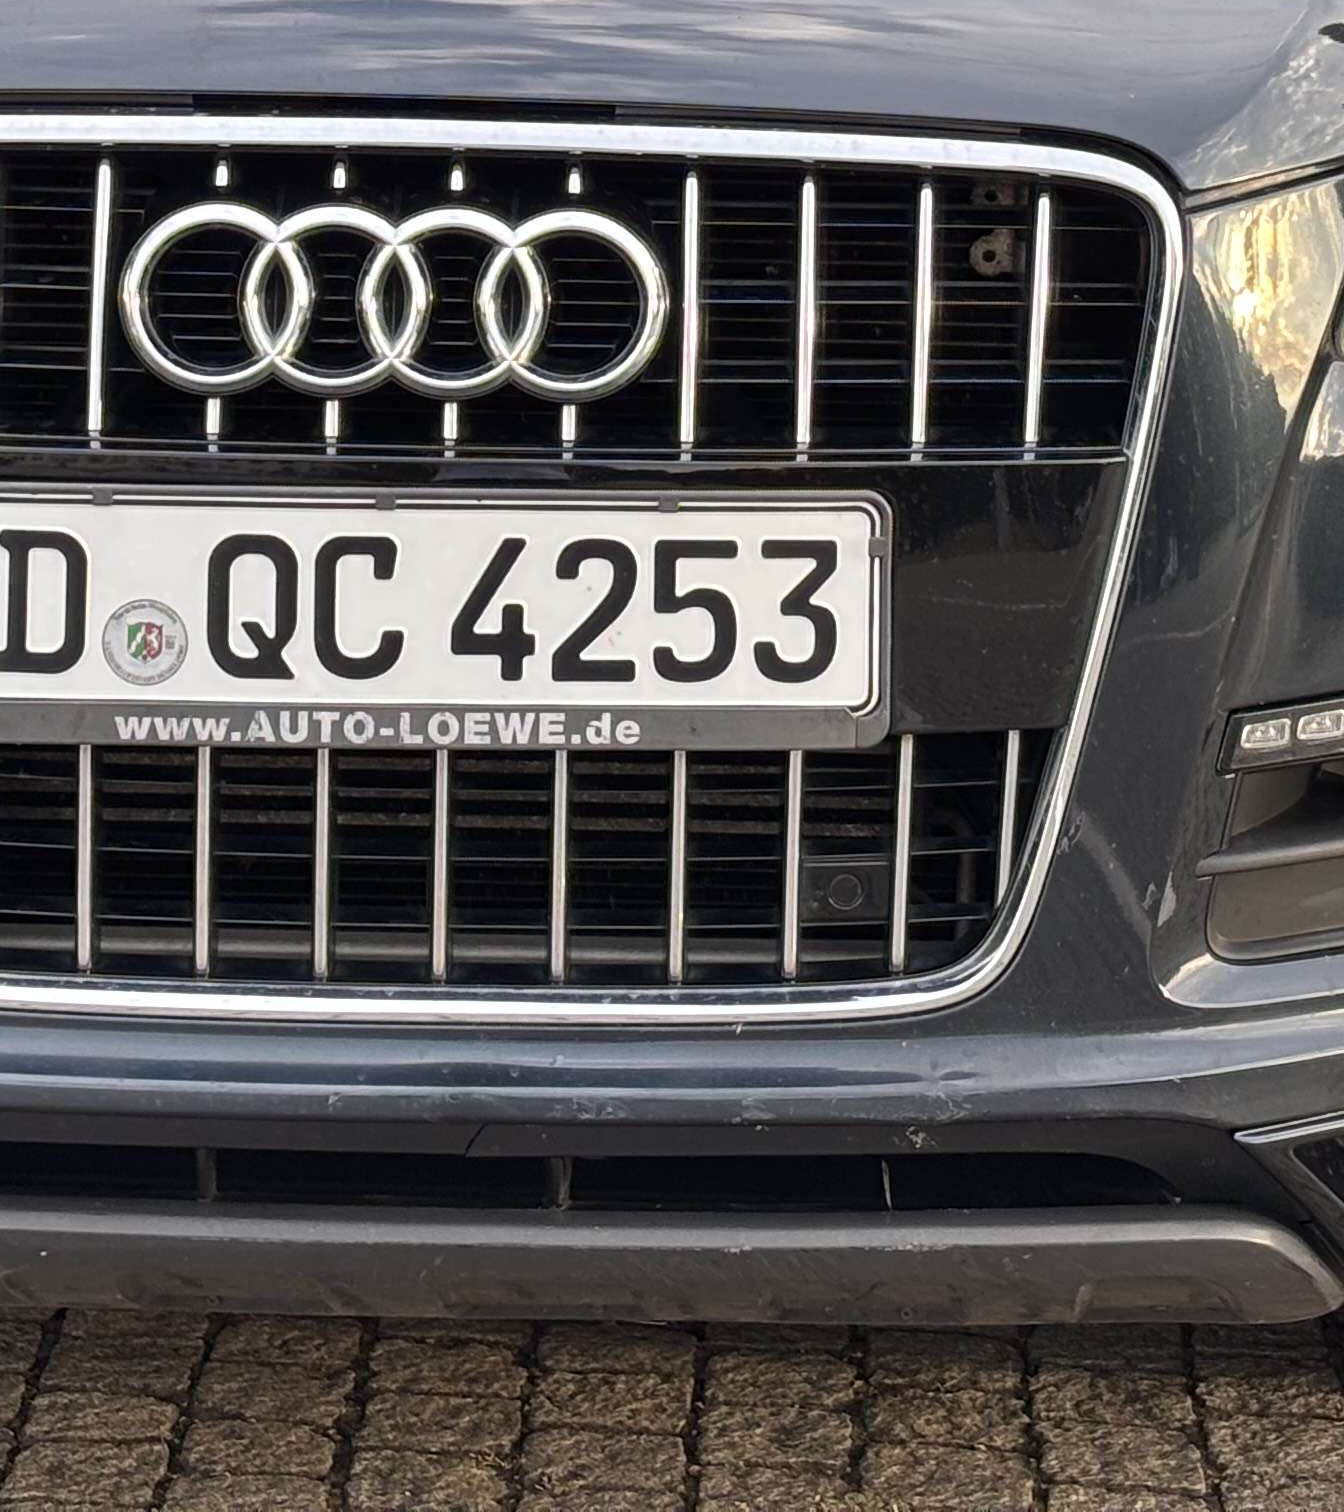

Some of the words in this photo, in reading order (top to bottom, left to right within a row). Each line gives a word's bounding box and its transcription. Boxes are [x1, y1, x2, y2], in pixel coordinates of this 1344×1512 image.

[207, 533, 405, 681] QC
[450, 537, 839, 684] 4253
[113, 710, 642, 745] www.AUTO-LOEWE.de
